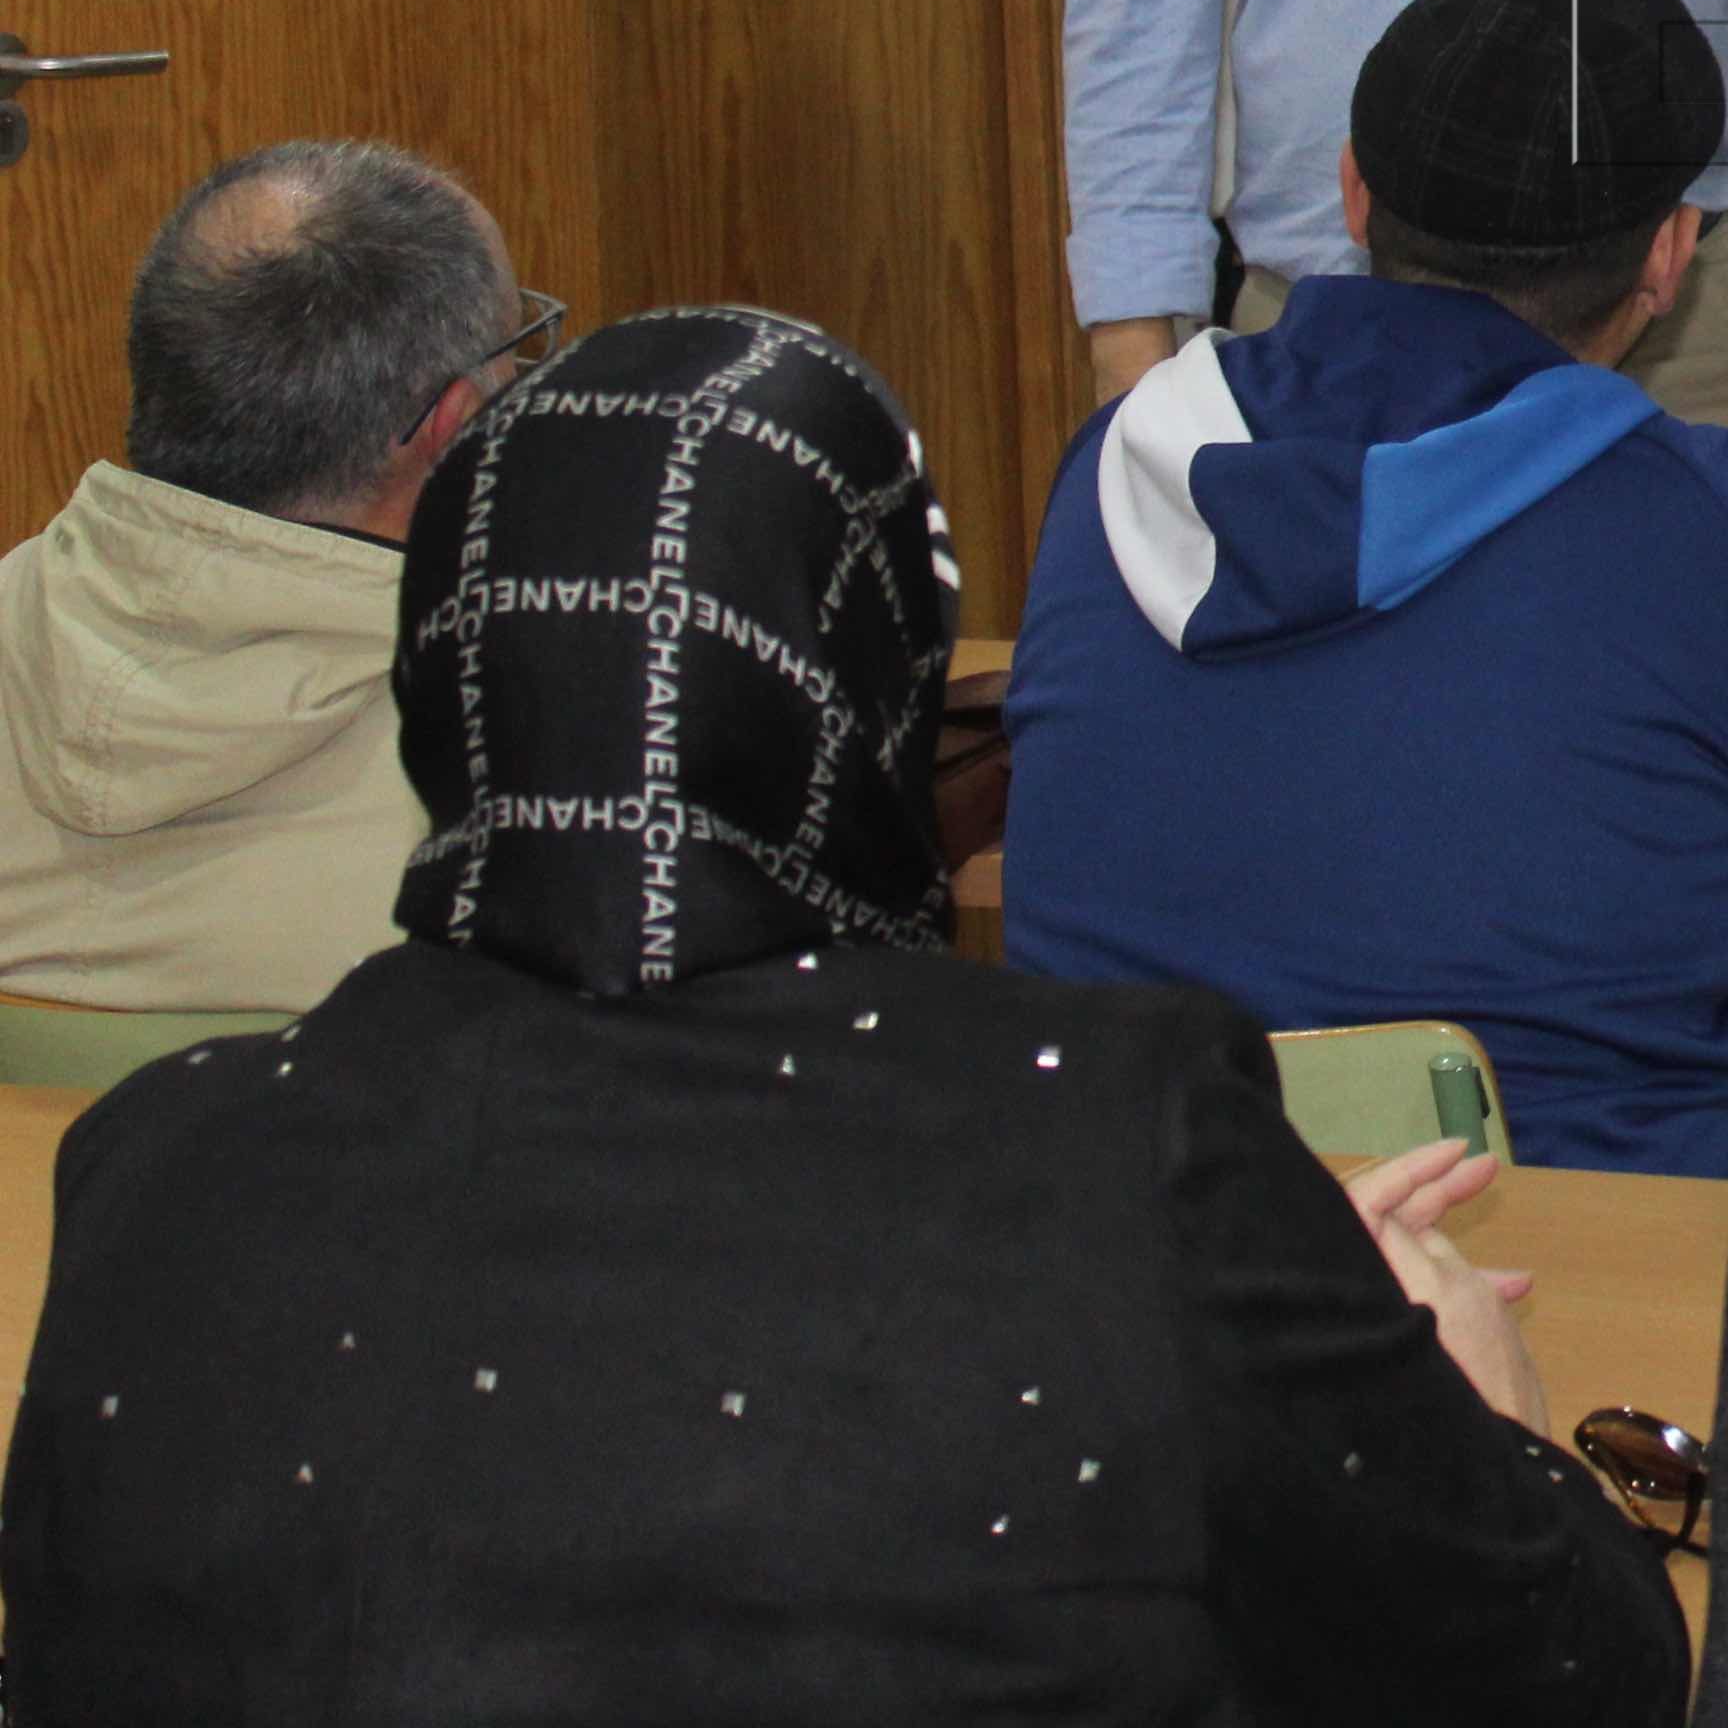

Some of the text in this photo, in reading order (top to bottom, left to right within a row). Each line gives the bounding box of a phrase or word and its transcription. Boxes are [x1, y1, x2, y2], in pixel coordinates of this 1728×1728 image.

[505, 392, 691, 418] CHANEL
[702, 401, 866, 514] CHANEL
[650, 411, 713, 591] CHANEL
[470, 577, 653, 617] CHANEL
[664, 583, 835, 703] CHANEL
[645, 605, 682, 805] CHANEL
[472, 794, 648, 833] CHANEL
